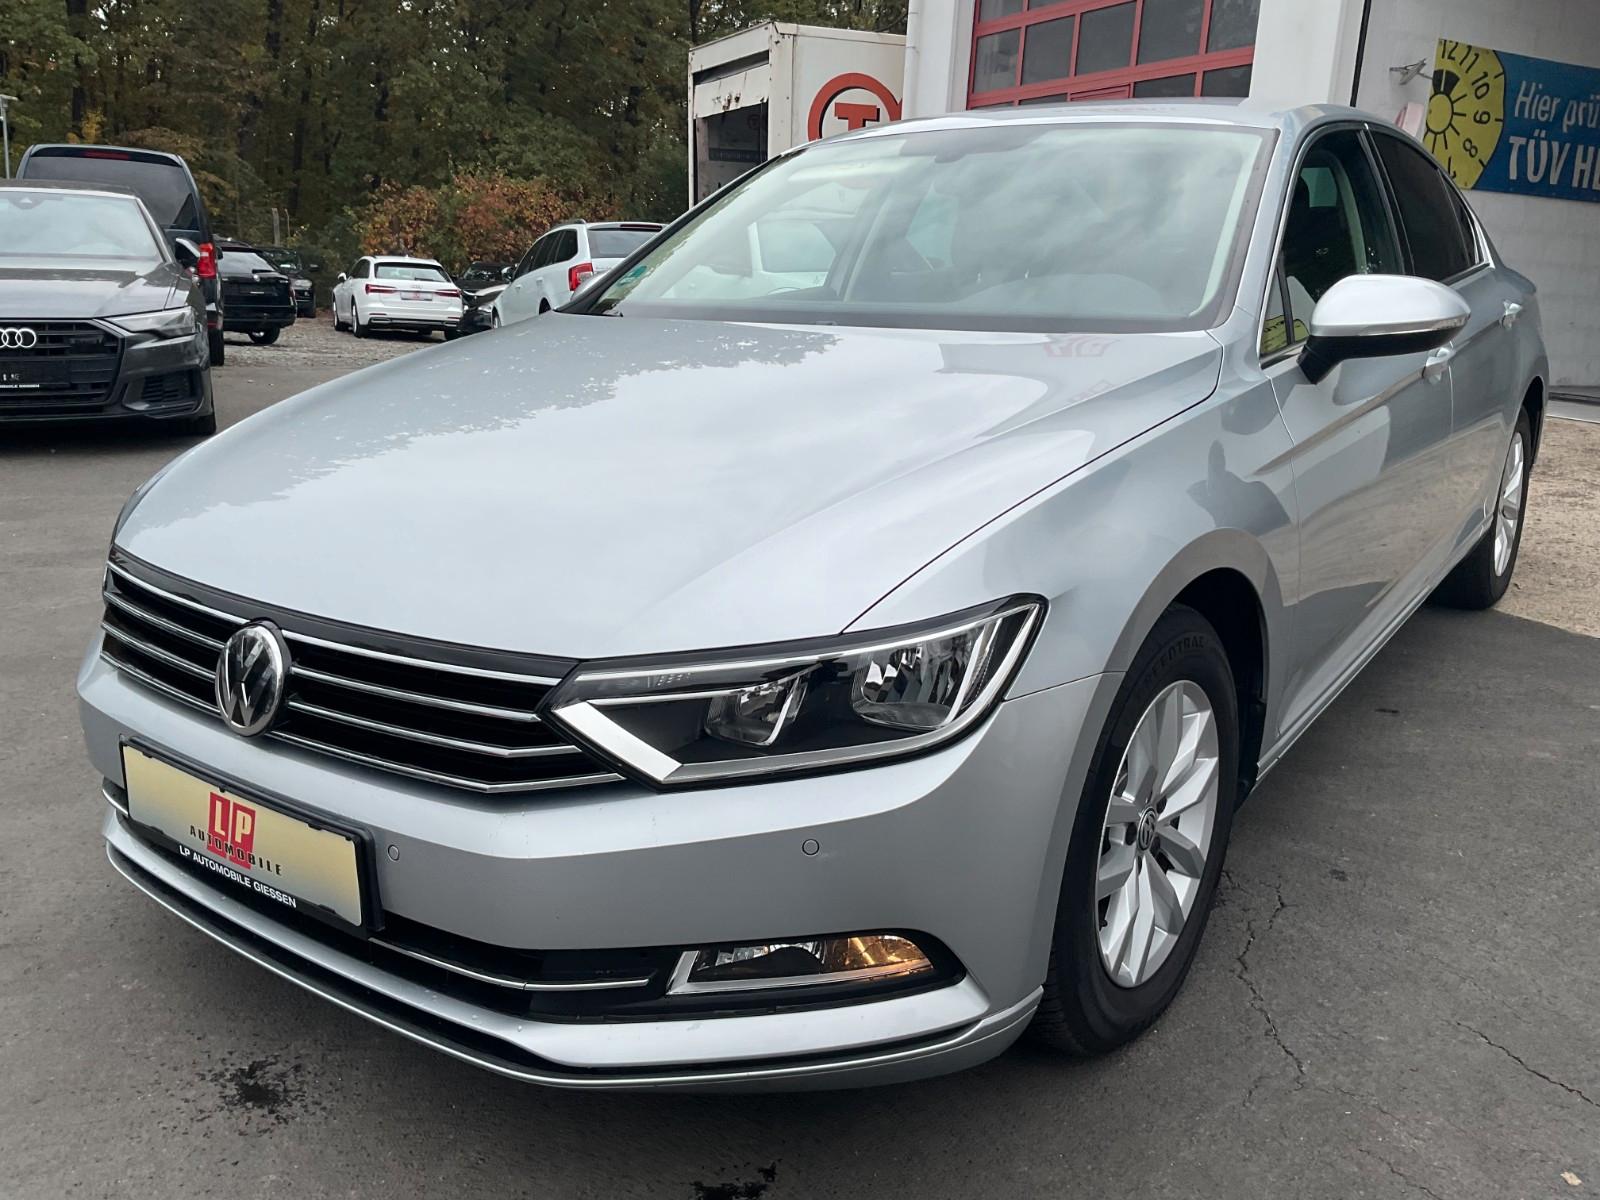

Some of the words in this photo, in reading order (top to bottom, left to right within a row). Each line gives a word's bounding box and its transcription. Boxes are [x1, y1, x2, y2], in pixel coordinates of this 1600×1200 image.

[1439, 39, 1459, 61] 12
[1459, 44, 1480, 74] 11
[1471, 71, 1490, 100] 10
[1514, 80, 1561, 122] Hier
[1473, 110, 1491, 125] 9
[1463, 138, 1478, 158] 8
[1508, 128, 1571, 185] TÜV
[214, 799, 253, 843] LP
[190, 825, 283, 876] AUTOMOBILE
[179, 844, 191, 857] LP
[193, 852, 252, 888] AUTOMOBILE
[253, 881, 297, 909] GIESSEN
